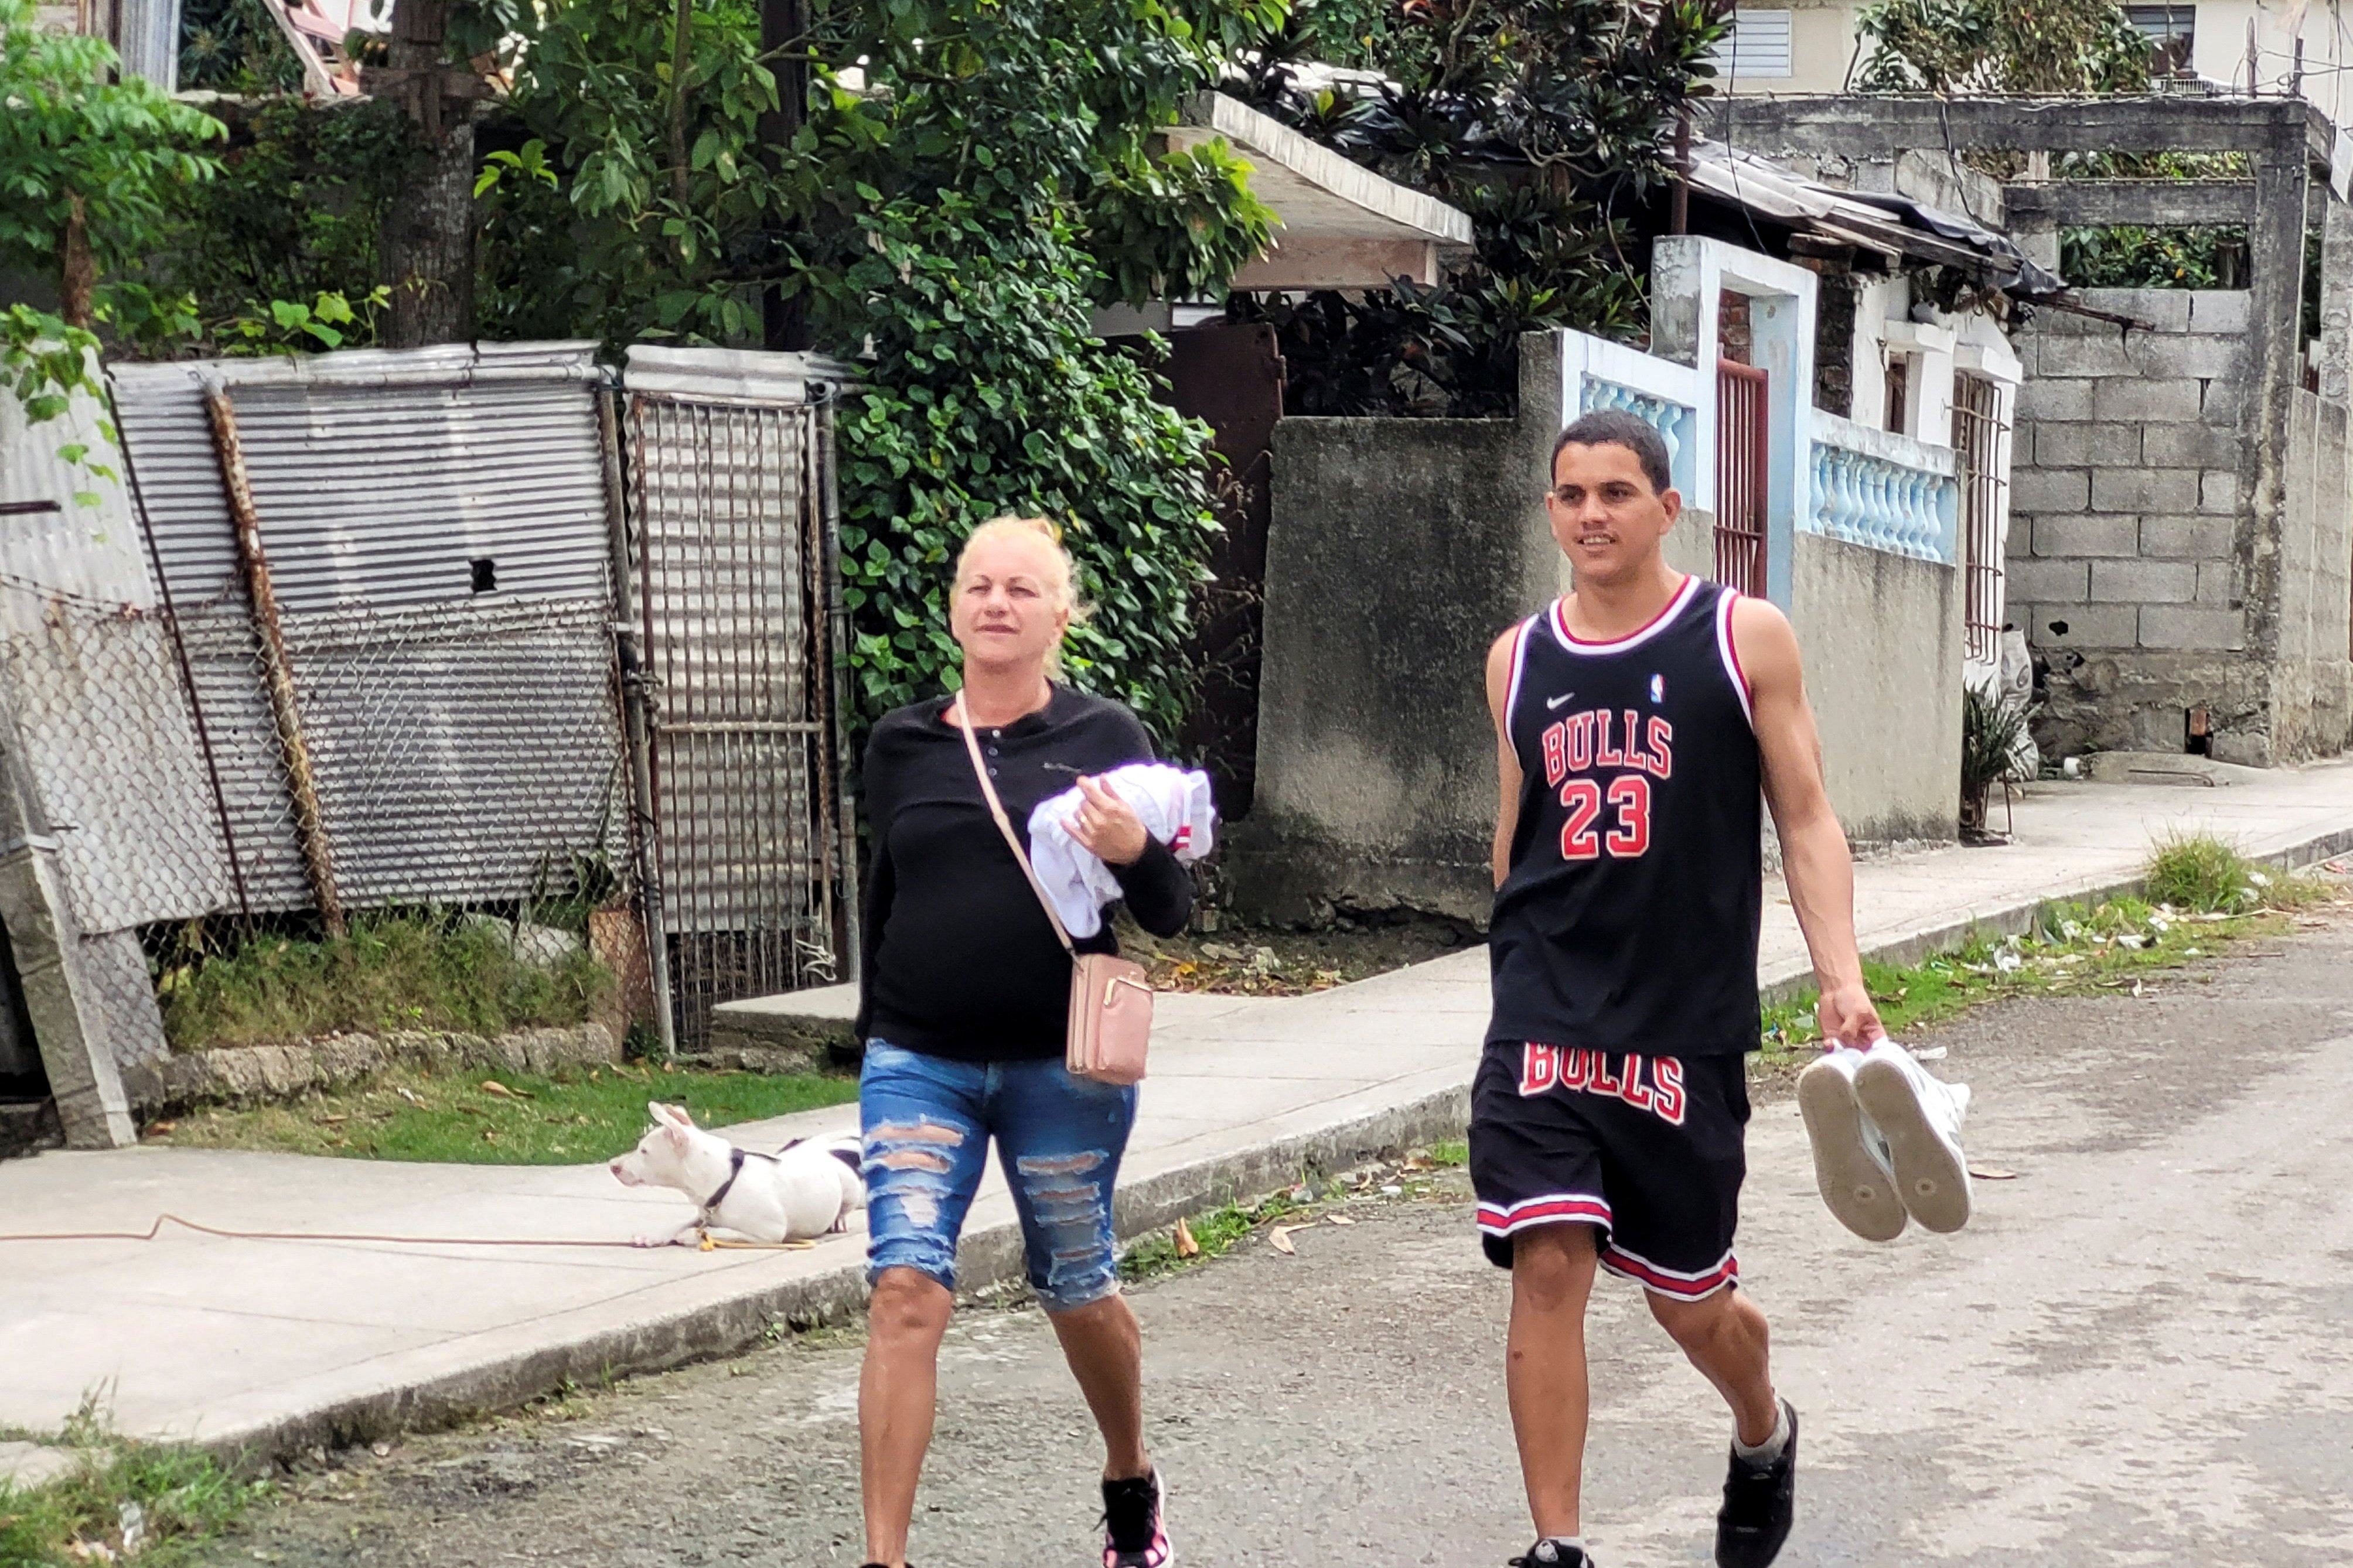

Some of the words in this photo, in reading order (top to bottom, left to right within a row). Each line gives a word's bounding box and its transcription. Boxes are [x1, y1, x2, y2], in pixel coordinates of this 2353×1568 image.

[1542, 709, 1672, 788] BULLS
[1560, 775, 1650, 861] 23
[1519, 1041, 1687, 1127] BULLS
